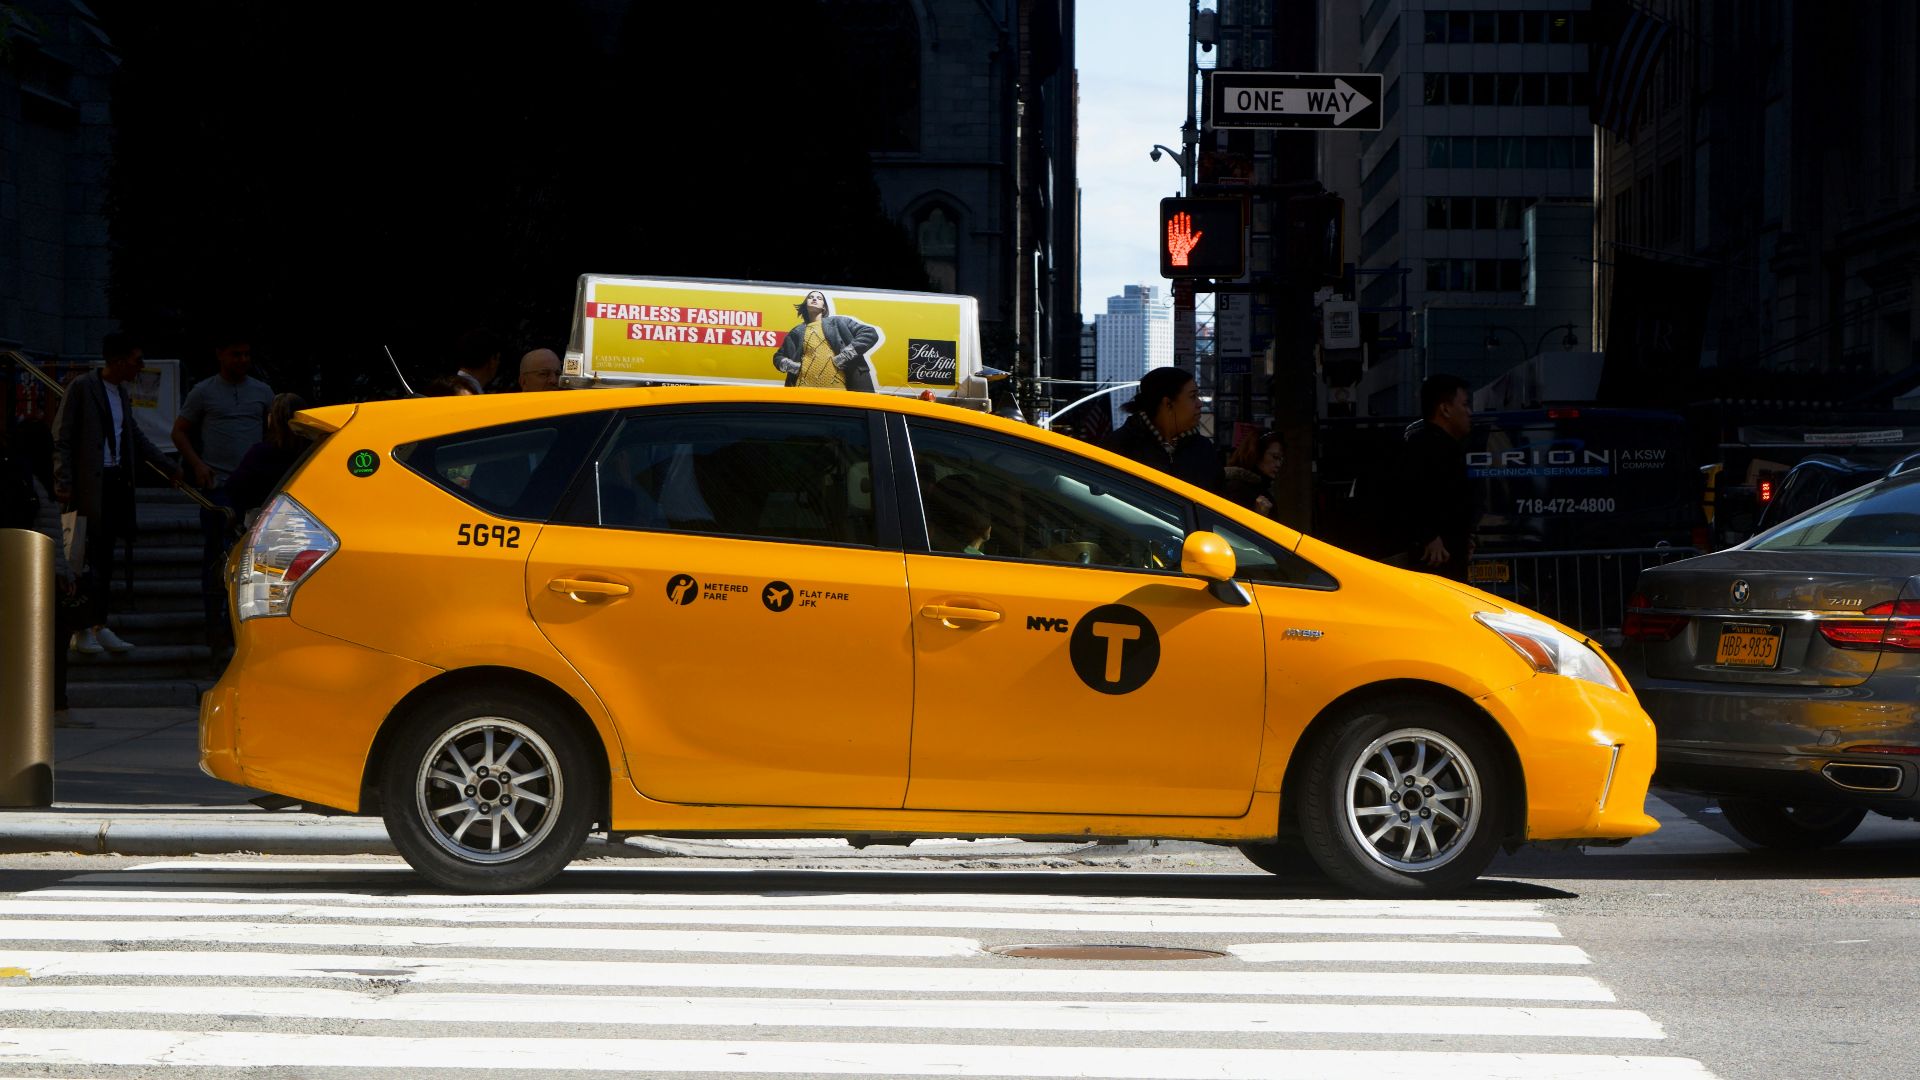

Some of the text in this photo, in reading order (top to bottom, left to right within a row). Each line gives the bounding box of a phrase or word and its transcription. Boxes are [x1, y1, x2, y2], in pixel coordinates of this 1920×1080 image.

[1237, 90, 1356, 113] ONE WAY
[597, 303, 758, 327] FEARLESS FASHION
[631, 323, 777, 347] STARTS AT SAKS
[908, 343, 940, 361] Saks
[908, 362, 952, 380] Avenue
[1466, 450, 1609, 465] ORION
[1621, 449, 1666, 460] A KSW
[1475, 467, 1602, 477] TECHNICAL SERVICES
[1622, 462, 1665, 470] COMPANY
[1516, 498, 1616, 514] 718-472-4800
[457, 523, 521, 549] 5G92
[704, 583, 749, 593] METERED
[799, 590, 849, 601] FLAT FARE
[703, 592, 728, 601] FARE
[799, 600, 817, 608] JFK
[1026, 616, 1069, 633] NYC
[1092, 621, 1141, 683] T
